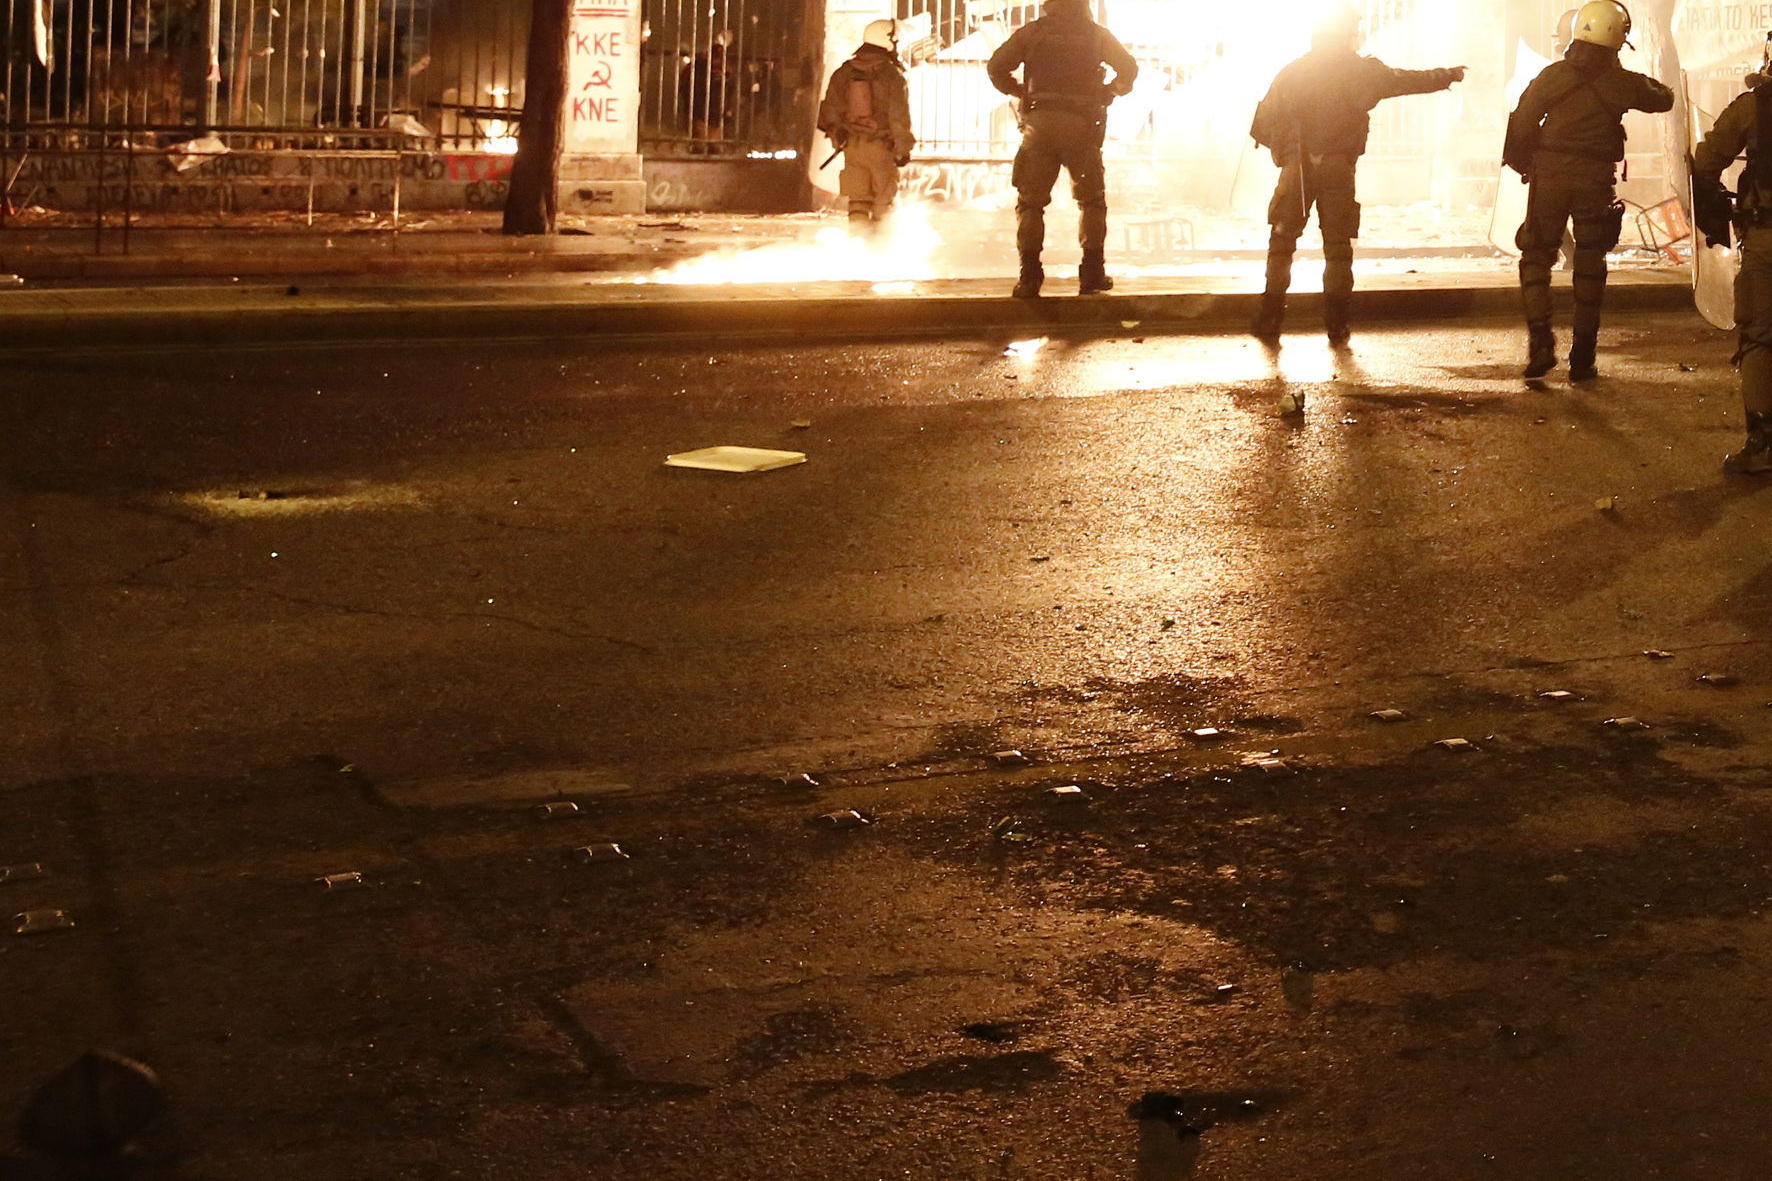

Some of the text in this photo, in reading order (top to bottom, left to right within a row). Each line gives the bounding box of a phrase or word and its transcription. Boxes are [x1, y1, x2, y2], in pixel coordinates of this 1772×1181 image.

[1724, 4, 1742, 31] ΤΟ
[576, 32, 621, 56] ΚΚΕ
[573, 97, 618, 122] ΚΝΕ
